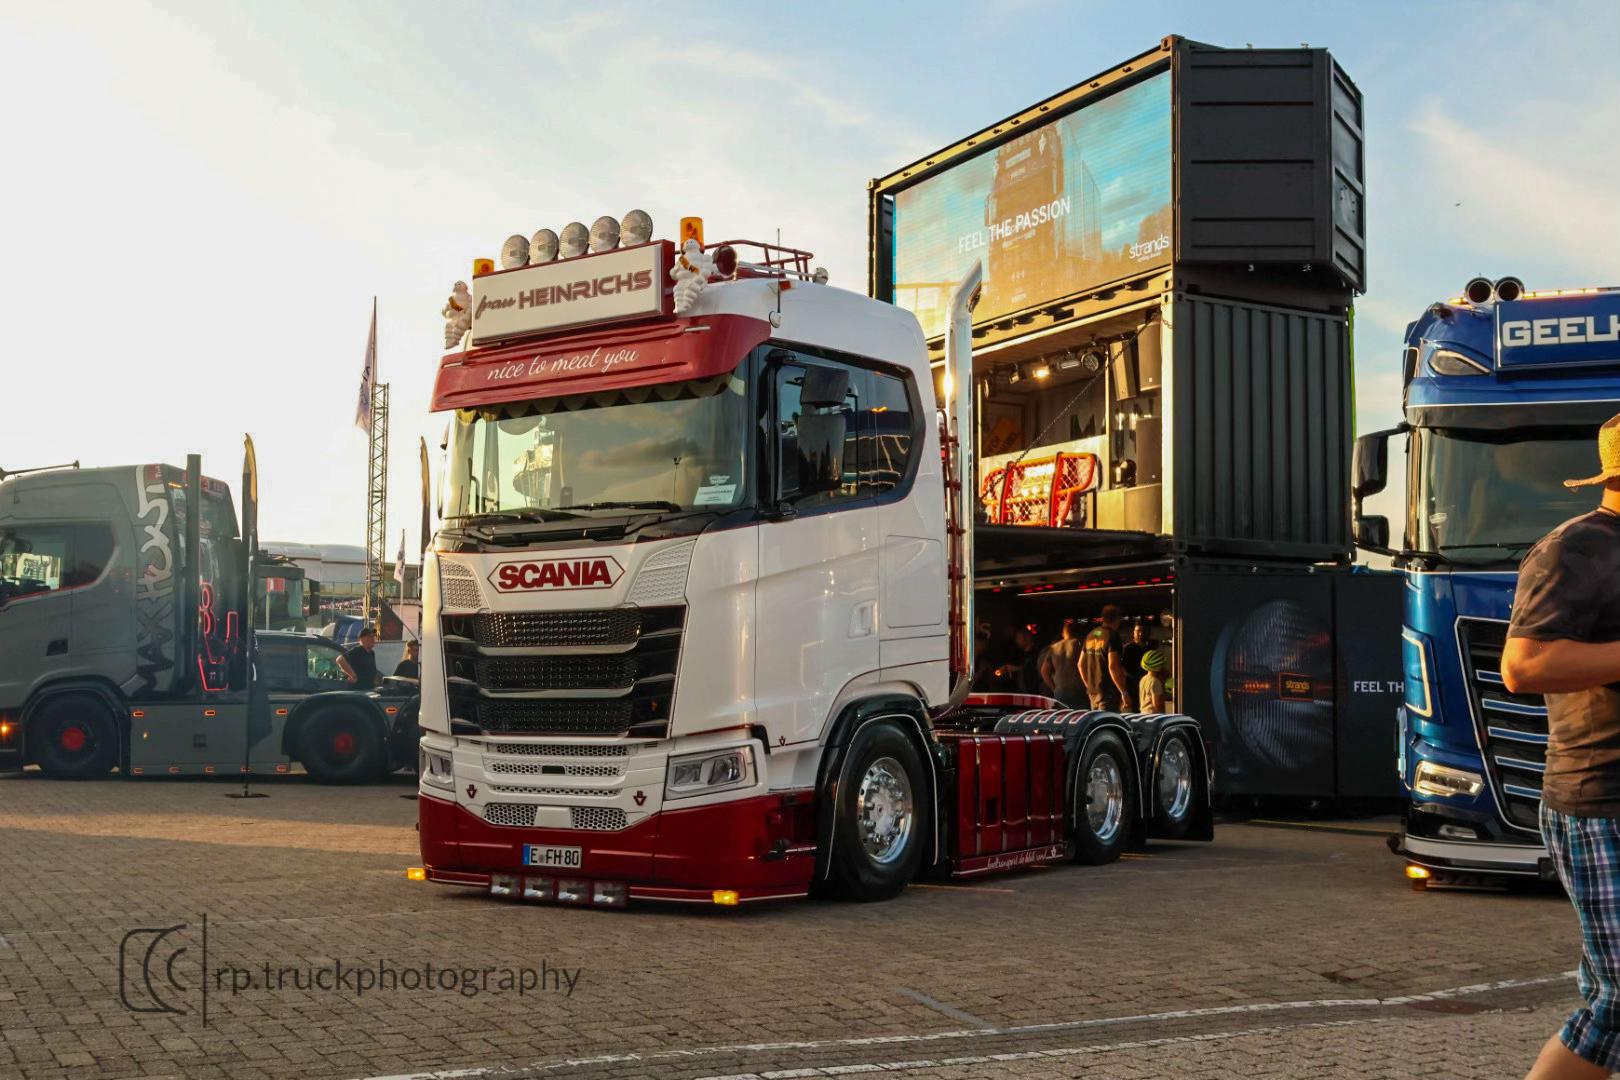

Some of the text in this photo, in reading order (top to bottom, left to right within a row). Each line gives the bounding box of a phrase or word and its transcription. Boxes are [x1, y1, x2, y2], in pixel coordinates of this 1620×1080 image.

[958, 230, 985, 254] FEEL
[988, 218, 1013, 242] THE
[1015, 195, 1071, 233] PASSION
[1129, 233, 1169, 259] strands
[475, 269, 653, 320] frau HEINRICHS
[487, 347, 639, 380] nice to meat you
[498, 560, 613, 590] SCANIA
[1353, 681, 1384, 693] FEEL
[530, 847, 539, 864] E
